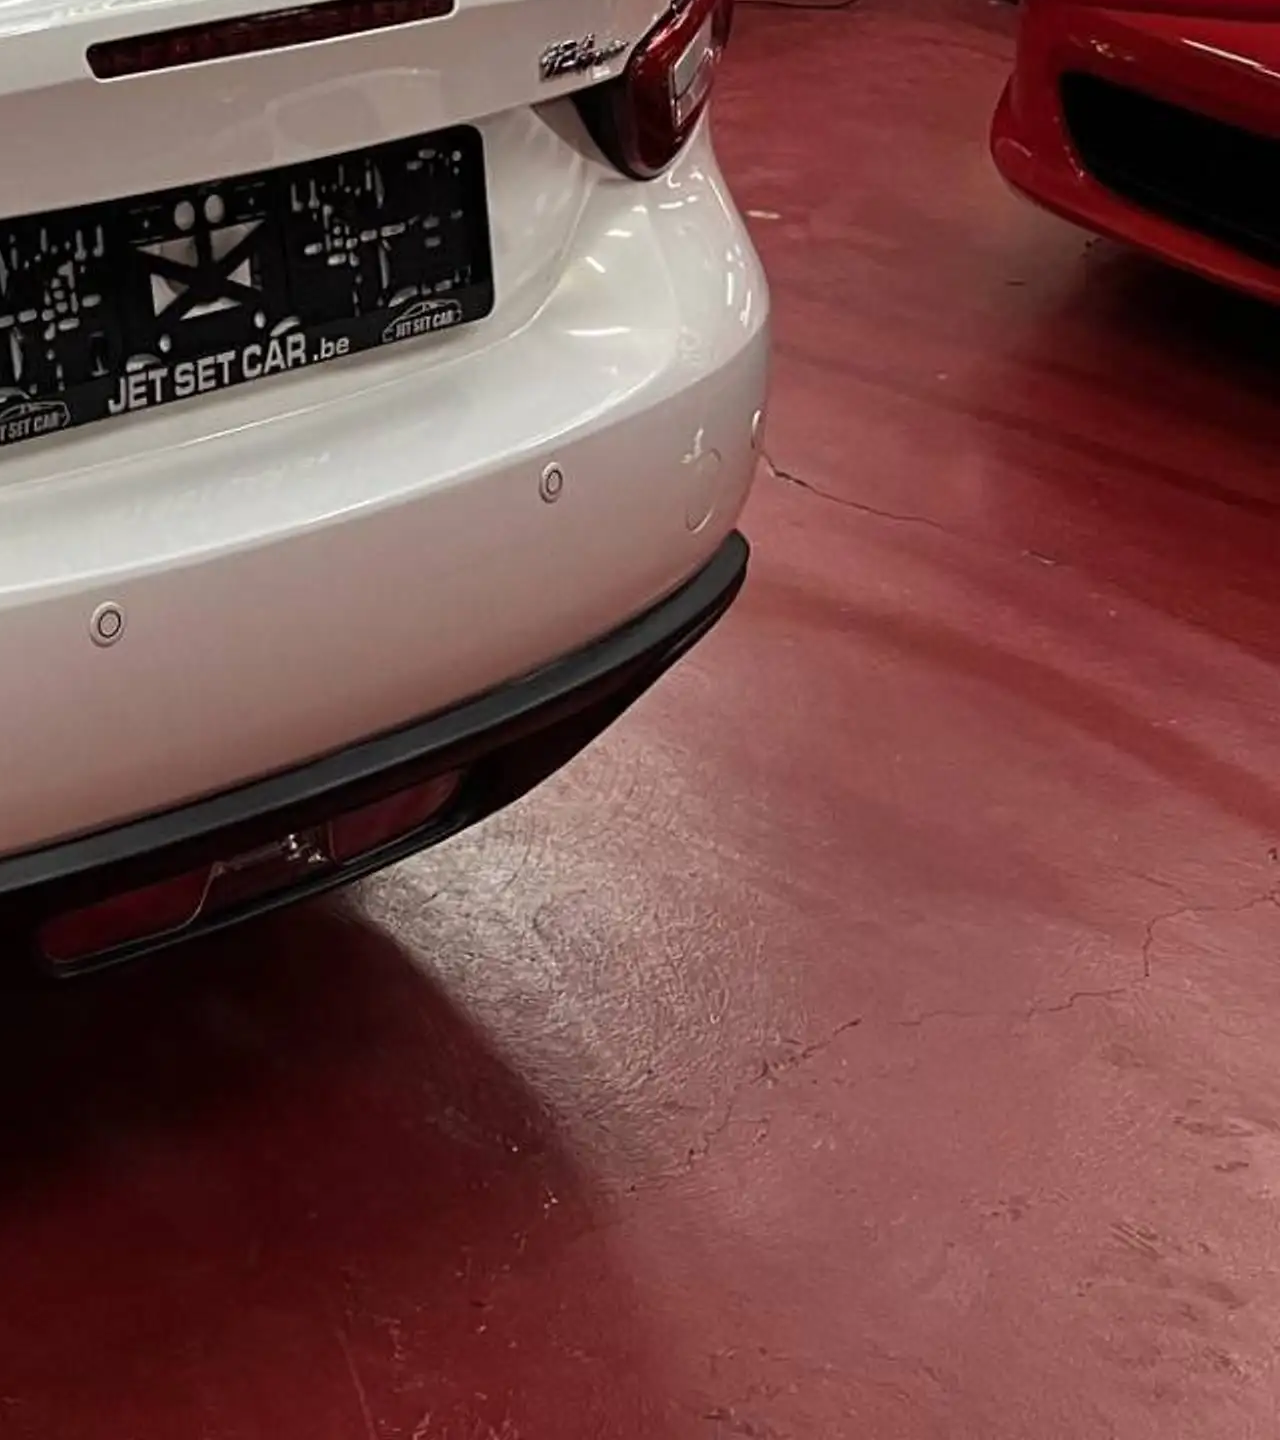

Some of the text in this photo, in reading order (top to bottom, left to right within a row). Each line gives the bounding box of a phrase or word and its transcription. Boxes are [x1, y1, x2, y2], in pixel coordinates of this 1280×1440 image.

[413, 315, 432, 334] SET
[108, 367, 169, 414] JET
[174, 350, 236, 398] SET
[242, 332, 308, 379] CAR
[8, 417, 32, 439] SET
